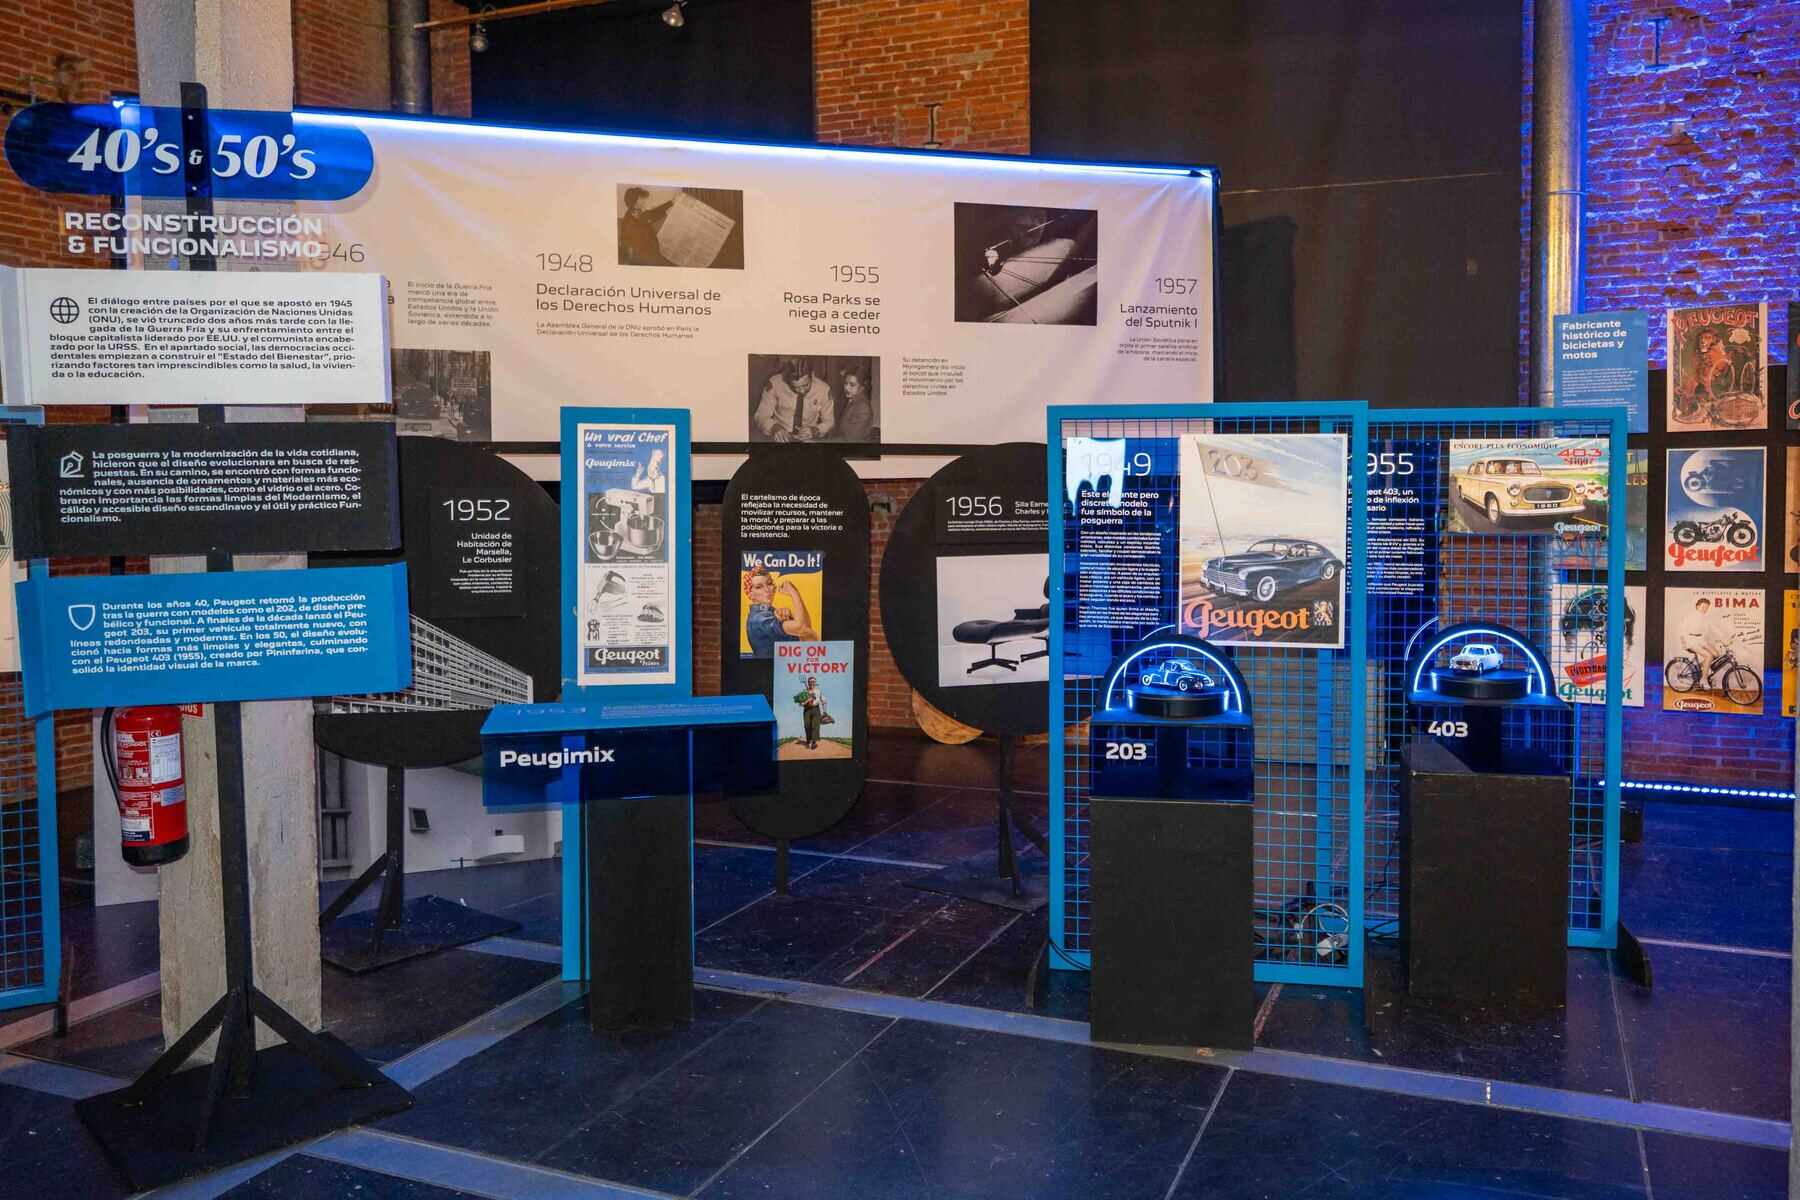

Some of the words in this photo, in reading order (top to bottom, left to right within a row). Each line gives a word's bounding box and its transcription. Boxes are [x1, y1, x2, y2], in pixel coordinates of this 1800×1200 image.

[189, 148, 203, 165] &
[65, 212, 321, 235] RECONSTRUCCIÓN
[68, 236, 86, 253] &
[93, 236, 322, 258] FUNCIONALISMO
[536, 253, 593, 273] 1948
[830, 264, 880, 284] 1955
[537, 283, 626, 298] Declaración
[631, 287, 699, 300] Universal
[703, 289, 721, 301] de
[1155, 277, 1198, 296] 1957
[88, 297, 98, 305] El
[100, 297, 140, 307] diálogo
[173, 298, 207, 306] países
[277, 300, 312, 308] apostó
[784, 292, 818, 304] Rosa
[823, 293, 861, 306] Parks
[865, 297, 880, 306] se
[537, 298, 558, 311] los
[563, 299, 634, 313] Derechos
[639, 302, 712, 316] Humanos
[1120, 304, 1198, 316] Lanzamiento
[789, 307, 827, 321] niega
[831, 310, 839, 319] a
[843, 309, 881, 320] ceder
[1125, 316, 1143, 328] del
[1145, 317, 1191, 329] Sputnik
[1562, 320, 1621, 331] Fabricante
[809, 324, 826, 333] su
[830, 323, 880, 335] asiento
[1562, 330, 1611, 340] histórico
[1613, 329, 1627, 338] de
[1562, 339, 1615, 350] bicicletas
[1617, 341, 1624, 349] y
[1562, 351, 1598, 360] motos
[52, 370, 65, 378] da
[88, 370, 145, 378] educación.
[584, 432, 602, 443] Un
[608, 432, 636, 443] vrai
[638, 432, 668, 443] Chef
[93, 451, 105, 459] La
[107, 452, 160, 460] posguerra
[171, 450, 181, 458] la
[183, 450, 258, 458] modernización
[260, 449, 273, 457] de
[275, 449, 285, 457] la
[286, 449, 308, 457] vida
[310, 449, 359, 457] cotidiana,
[1081, 490, 1100, 500] Este
[1140, 492, 1159, 500] pero
[1383, 487, 1401, 496] 403,
[741, 501, 772, 509] reflejaba
[1385, 495, 1419, 504] inflexión
[443, 499, 511, 521] 1952
[946, 496, 1003, 516] 1956
[1081, 508, 1095, 516] fue
[1096, 507, 1130, 516] símbolo
[1131, 508, 1143, 517] de
[1144, 509, 1152, 517] la
[61, 513, 122, 523] cionalismo.
[1081, 518, 1123, 526] posguerra
[741, 523, 785, 532] poblaciones
[471, 532, 500, 540] Unidad
[501, 532, 512, 540] de
[501, 540, 512, 548] de
[476, 548, 512, 556] Marsella,
[1669, 543, 1760, 567] Peugeot
[462, 556, 473, 564] Le
[743, 553, 762, 568] We
[764, 553, 786, 568] Can
[789, 554, 805, 567] Do
[808, 553, 821, 567] It!
[102, 602, 144, 610] Durante
[147, 601, 163, 609] los
[166, 600, 191, 608] años
[195, 599, 210, 608] 40,
[213, 598, 256, 607] Peugeot
[259, 596, 295, 605] retomó
[311, 594, 366, 604] producción
[1714, 597, 1759, 609] BIMA
[1184, 600, 1311, 638] Peugeot
[594, 647, 660, 665] Peugeot
[779, 646, 802, 656] DIG
[807, 646, 826, 657] ON
[787, 662, 848, 673] VICTORY
[1428, 721, 1468, 737] 403
[1106, 742, 1148, 760] 203
[500, 746, 615, 769] Peugimix
